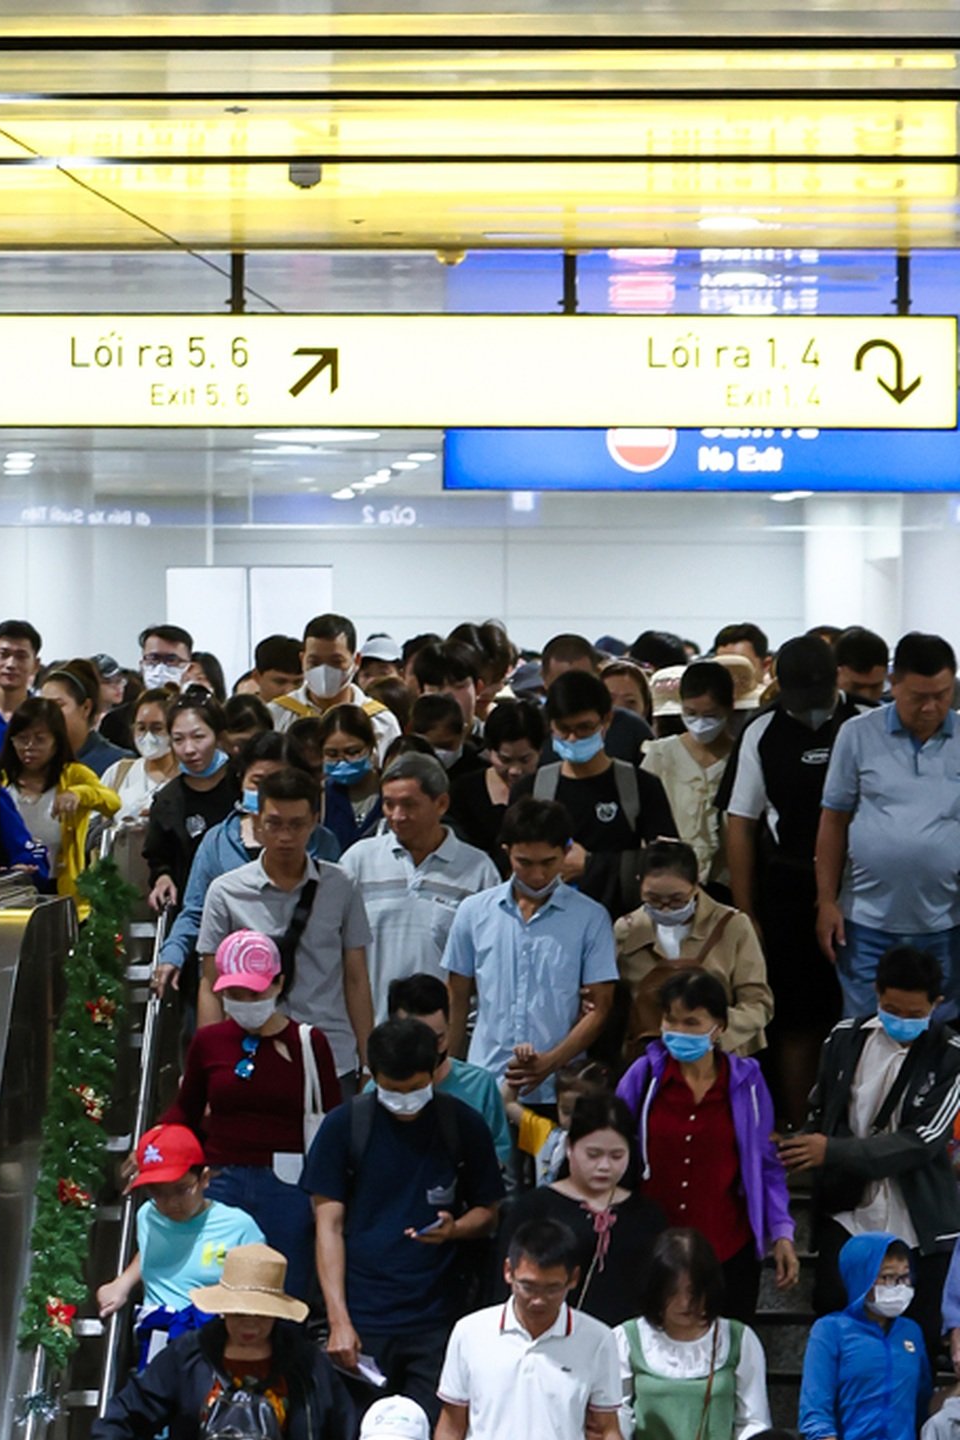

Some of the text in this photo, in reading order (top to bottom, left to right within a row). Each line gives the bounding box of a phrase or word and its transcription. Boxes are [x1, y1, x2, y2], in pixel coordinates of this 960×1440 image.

[70, 330, 123, 368] Lối
[138, 345, 174, 368] ra
[230, 336, 249, 368] 6
[647, 332, 701, 368] Lối
[715, 346, 750, 368] ra
[801, 337, 820, 368] 4
[150, 383, 195, 406] Exit
[235, 383, 250, 406] 6
[725, 383, 771, 407] Exit
[806, 384, 821, 406] 4
[697, 446, 735, 472] No
